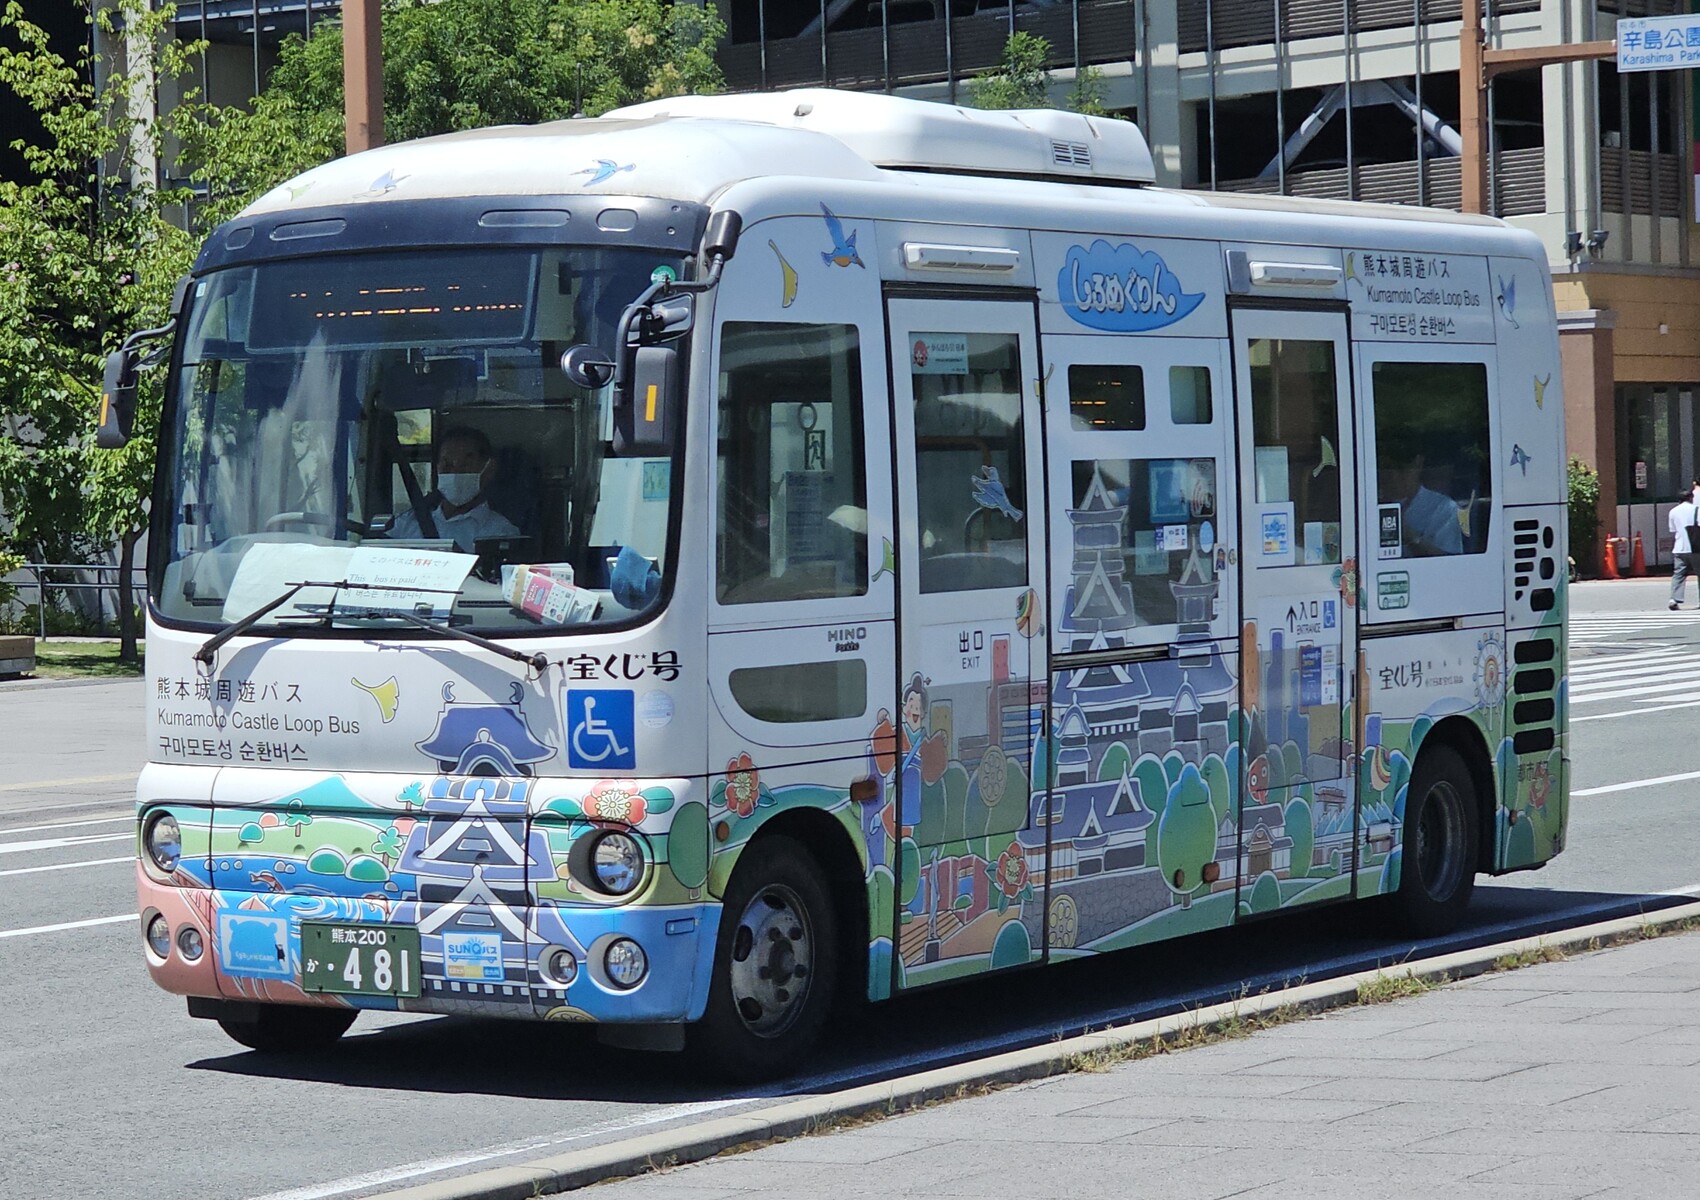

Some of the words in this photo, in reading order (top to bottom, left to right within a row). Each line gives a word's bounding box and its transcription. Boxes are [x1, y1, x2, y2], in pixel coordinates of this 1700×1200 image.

[1623, 27, 1700, 51] 辛島公園
[1623, 51, 1674, 65] Karashima
[1363, 254, 1451, 279] 熊本城周遊バス
[1366, 285, 1412, 305] Kumamoto
[1414, 287, 1441, 305] Castle
[1442, 289, 1462, 309] Loop
[1464, 290, 1481, 307] Bus
[1370, 314, 1416, 336] 구마모토성
[349, 574, 366, 583] This
[374, 574, 389, 583] bus
[1299, 601, 1318, 620] 入口
[828, 627, 867, 642] HINO
[959, 630, 984, 653] 出口
[566, 650, 683, 682] 宝くじ号
[962, 656, 980, 669] EXIT
[1379, 660, 1424, 690] 宝くじ号
[157, 676, 302, 703] 熊本城周遊バス
[158, 708, 227, 729] Kumamoto
[231, 711, 279, 731] Castle
[284, 713, 323, 736] Loop
[328, 715, 360, 734] Bus
[159, 736, 233, 761] 구마모토성
[239, 741, 309, 763] 순환버스
